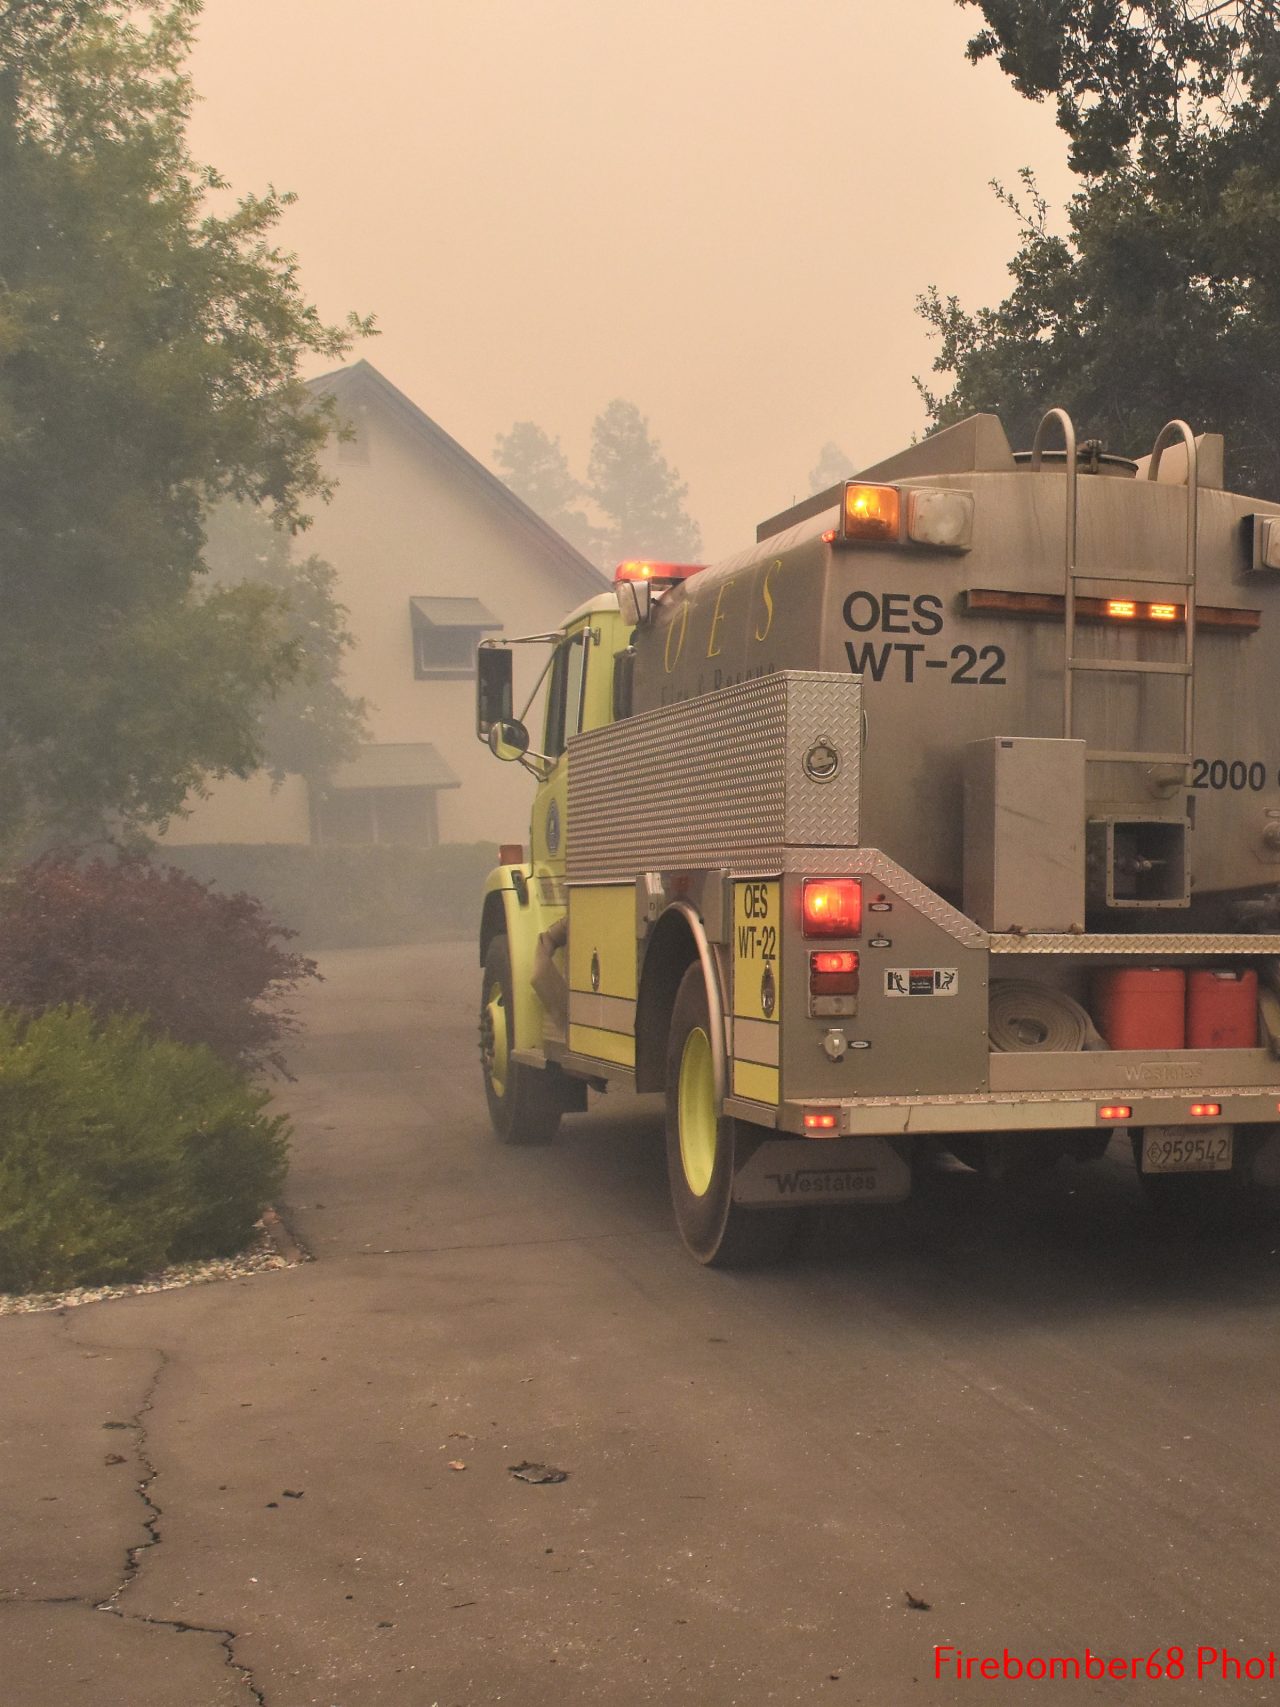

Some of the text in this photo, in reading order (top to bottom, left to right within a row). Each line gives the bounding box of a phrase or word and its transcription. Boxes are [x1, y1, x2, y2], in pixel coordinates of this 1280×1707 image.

[664, 559, 782, 673] OES
[843, 590, 944, 636] OES
[844, 641, 1007, 685] WT-22
[1192, 758, 1266, 791] 2000
[744, 884, 768, 919] OES
[738, 926, 776, 960] WT-22
[1162, 1139, 1228, 1164] 959542
